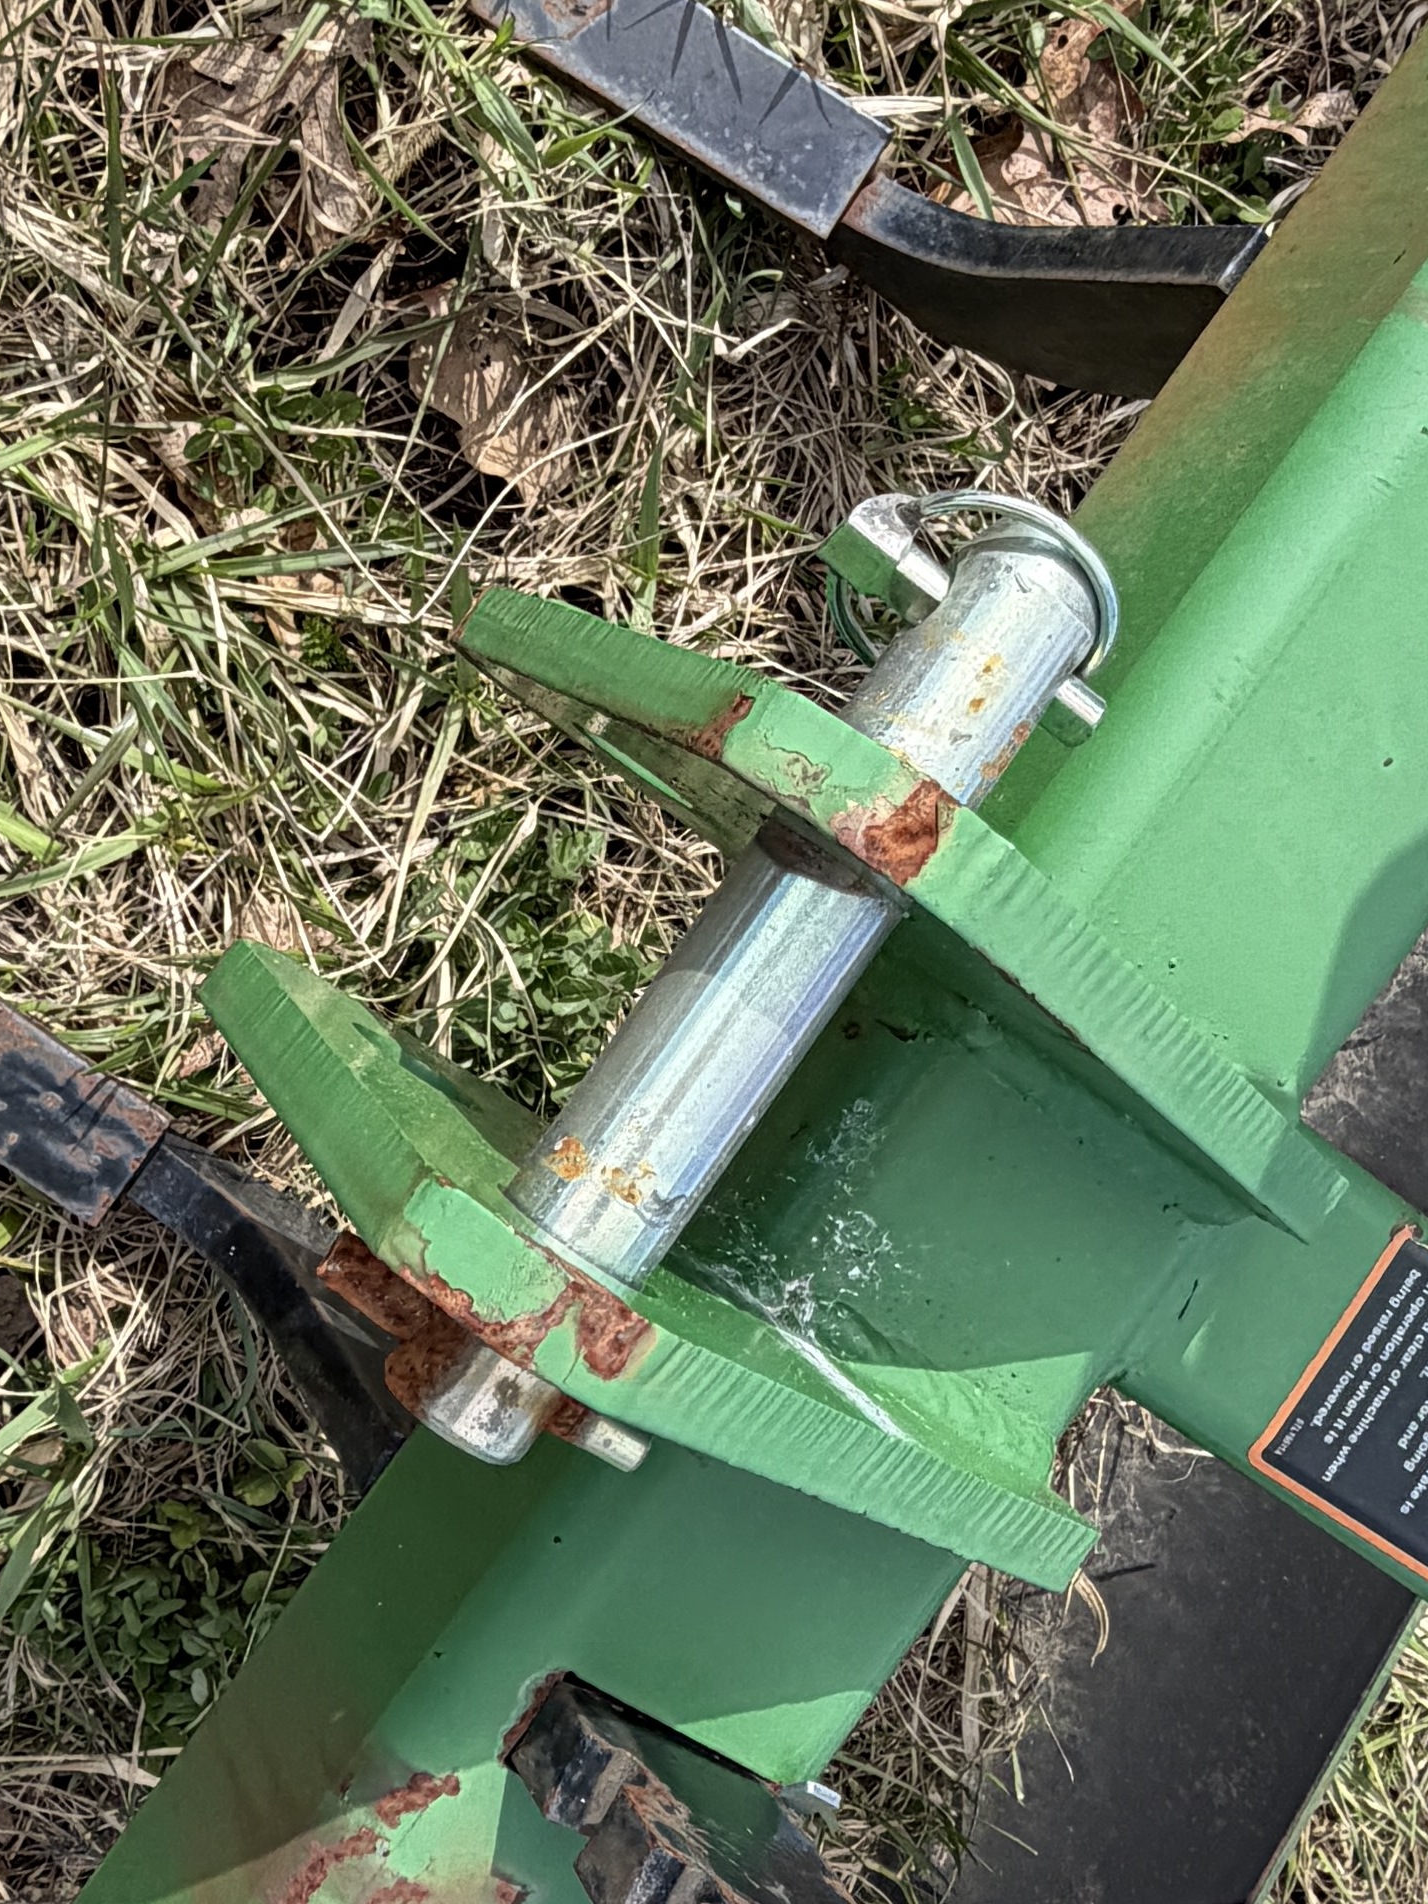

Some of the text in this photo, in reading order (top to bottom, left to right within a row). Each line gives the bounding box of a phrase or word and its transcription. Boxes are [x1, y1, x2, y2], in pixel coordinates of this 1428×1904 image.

[1388, 1268, 1422, 1309] being
[1361, 1308, 1394, 1354] raised
[1379, 1296, 1426, 1362] operation
[1350, 1353, 1364, 1371] or
[1399, 1333, 1425, 1370] clear
[1368, 1362, 1382, 1380] or
[1387, 1368, 1401, 1387] of
[1341, 1380, 1372, 1418] when
[1347, 1384, 1391, 1444] machine
[1323, 1430, 1339, 1445] is
[1332, 1417, 1347, 1430] it
[1397, 1420, 1419, 1450] and
[1321, 1445, 1352, 1482] when
[1399, 1500, 1415, 1515] is
